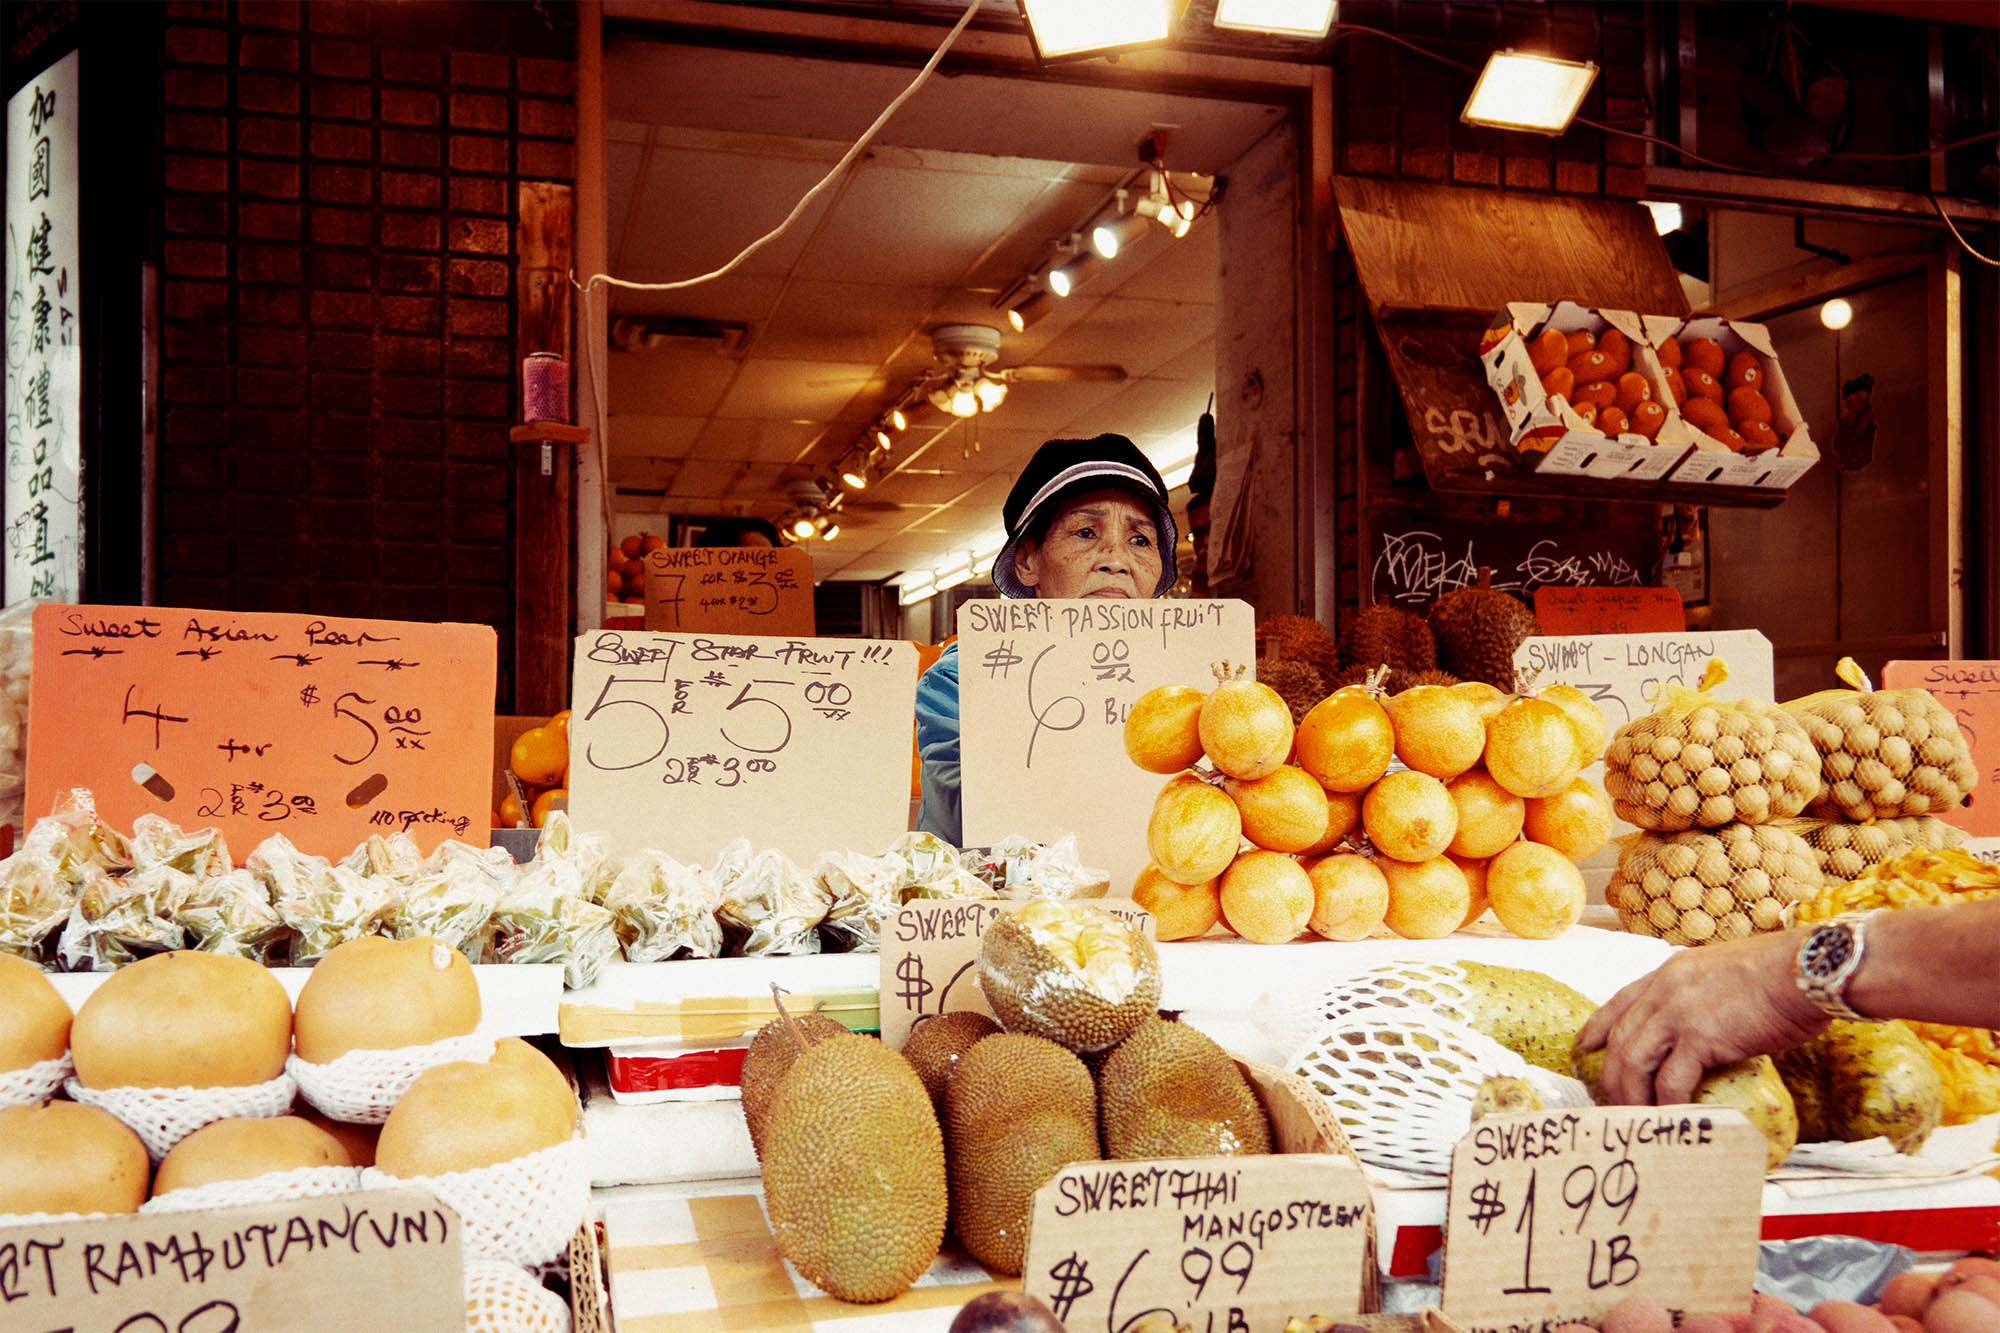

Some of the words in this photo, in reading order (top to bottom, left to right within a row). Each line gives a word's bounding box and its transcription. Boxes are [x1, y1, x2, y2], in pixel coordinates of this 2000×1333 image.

[60, 614, 162, 638] Sweet
[184, 618, 279, 642] Asian
[305, 622, 401, 648] Pear
[1626, 640, 1714, 677] LONGAN
[1056, 1167, 1167, 1216] SWEET
[1183, 1201, 1366, 1250] MANGOSTEEN
[1588, 1234, 1642, 1291] LB
